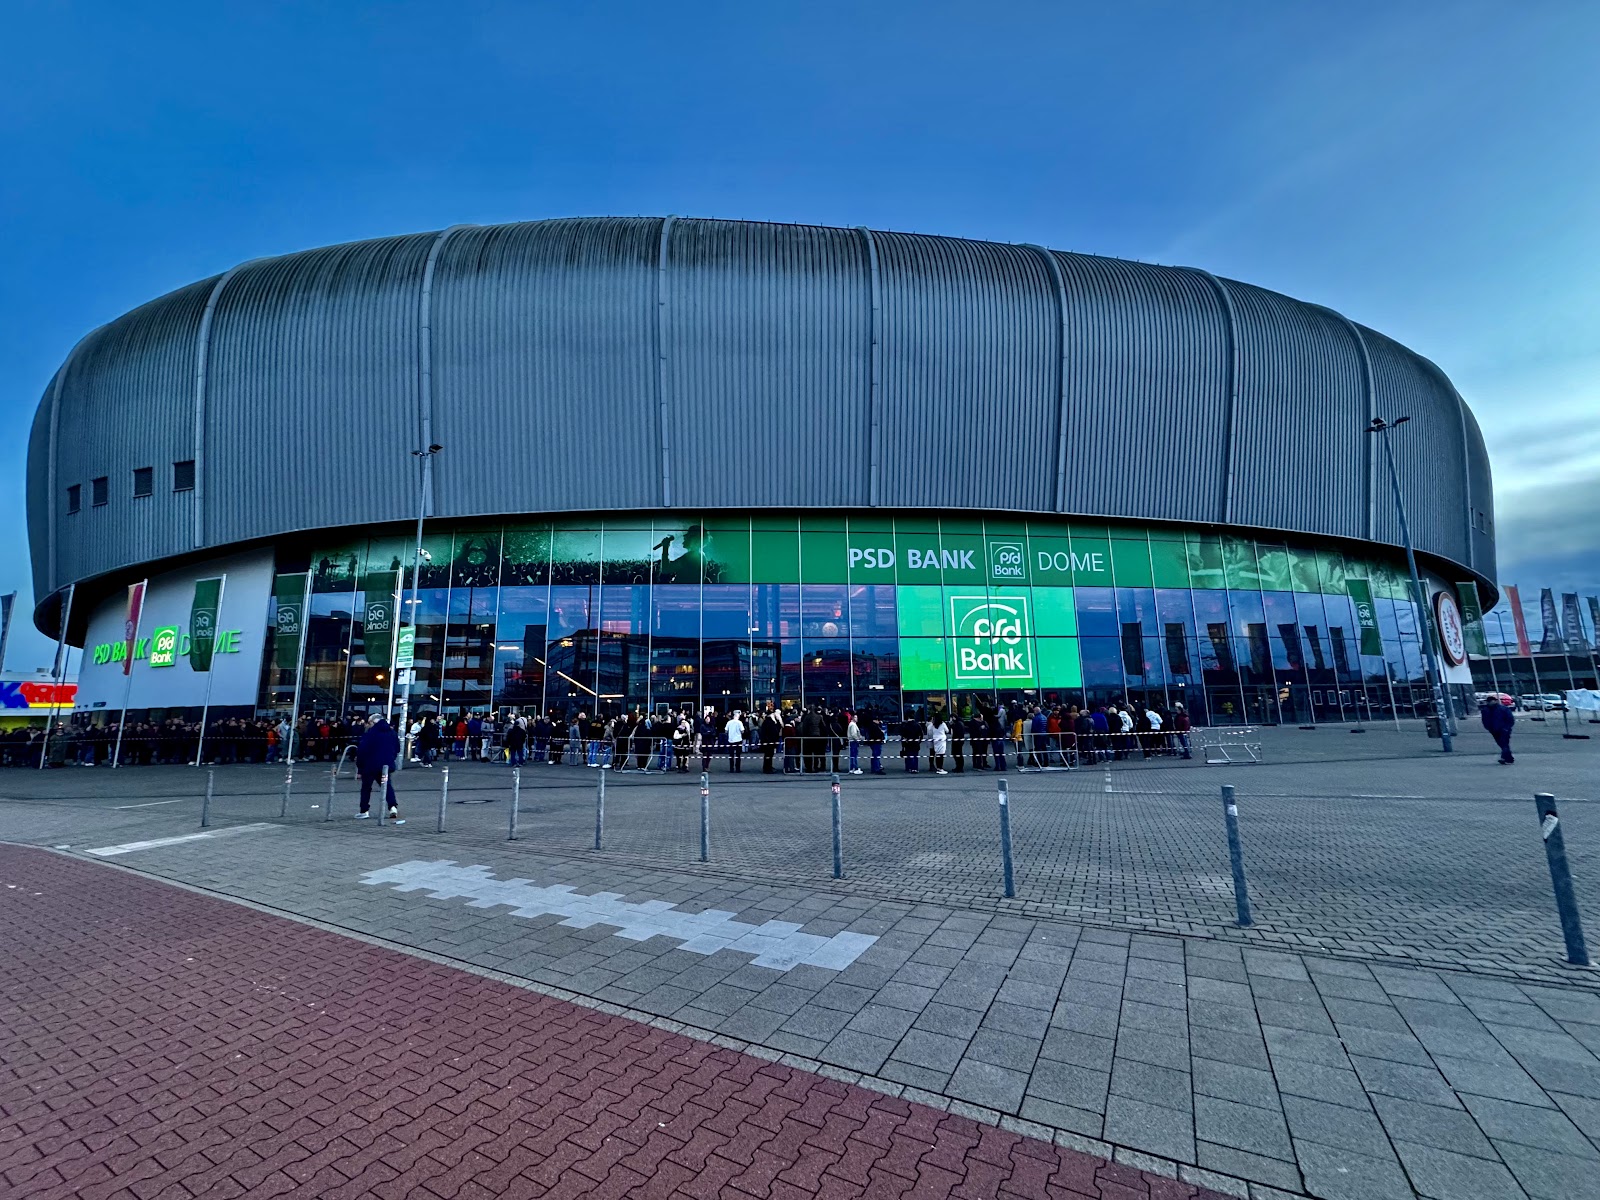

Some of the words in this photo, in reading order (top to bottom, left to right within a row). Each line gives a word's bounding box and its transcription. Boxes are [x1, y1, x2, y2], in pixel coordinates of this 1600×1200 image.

[849, 548, 895, 568] PSD
[907, 549, 976, 569] BANK
[1038, 552, 1104, 571] DOME
[994, 565, 1022, 576] Bank
[93, 644, 110, 664] PSD
[111, 638, 147, 662] BAK
[178, 631, 241, 655] DME
[151, 652, 172, 664] Bank
[961, 648, 1025, 671] Bank
